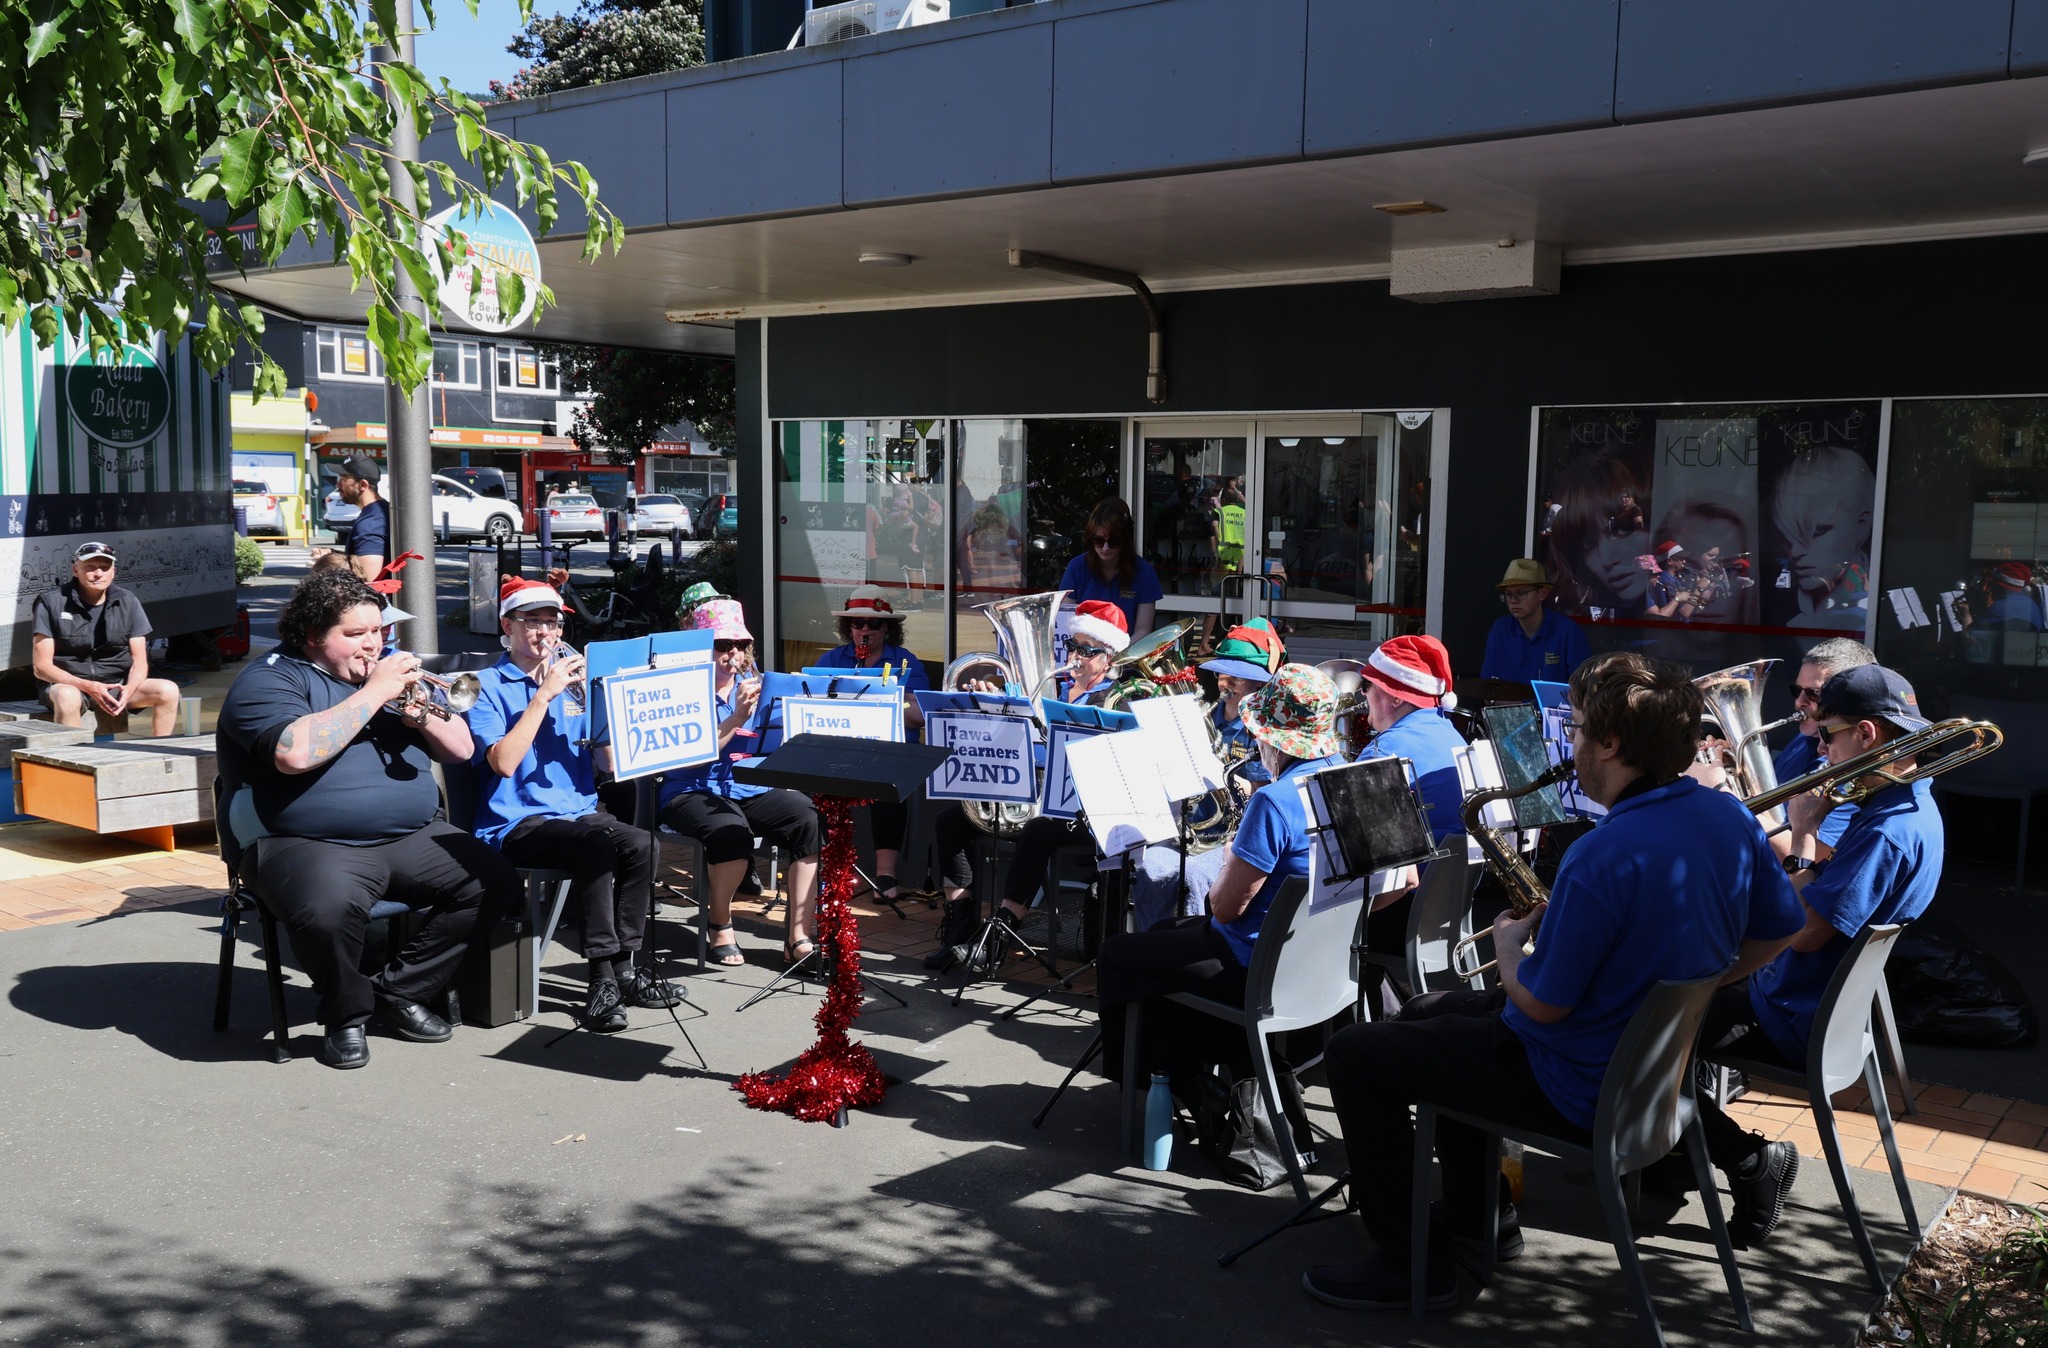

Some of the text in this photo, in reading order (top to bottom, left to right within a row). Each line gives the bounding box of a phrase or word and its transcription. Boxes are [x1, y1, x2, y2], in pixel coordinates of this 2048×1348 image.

[473, 231, 530, 250] CHRISTMAS IN
[473, 241, 536, 280] TAWA
[457, 270, 493, 285] Winow
[470, 310, 482, 322] to
[479, 301, 490, 312] Be
[97, 350, 144, 388] Nada
[91, 386, 150, 430] Bakery
[1570, 421, 1633, 445] KEUNE
[1782, 417, 1859, 446] KEUNE
[329, 447, 377, 458] ASIAN
[1664, 435, 1758, 467] KEUNE
[667, 486, 703, 495] Laundromat
[626, 687, 672, 706] Tawa
[628, 701, 701, 725] Learners
[805, 712, 851, 729] Tawa
[947, 725, 993, 742] Tawa
[948, 741, 1020, 760] Learners
